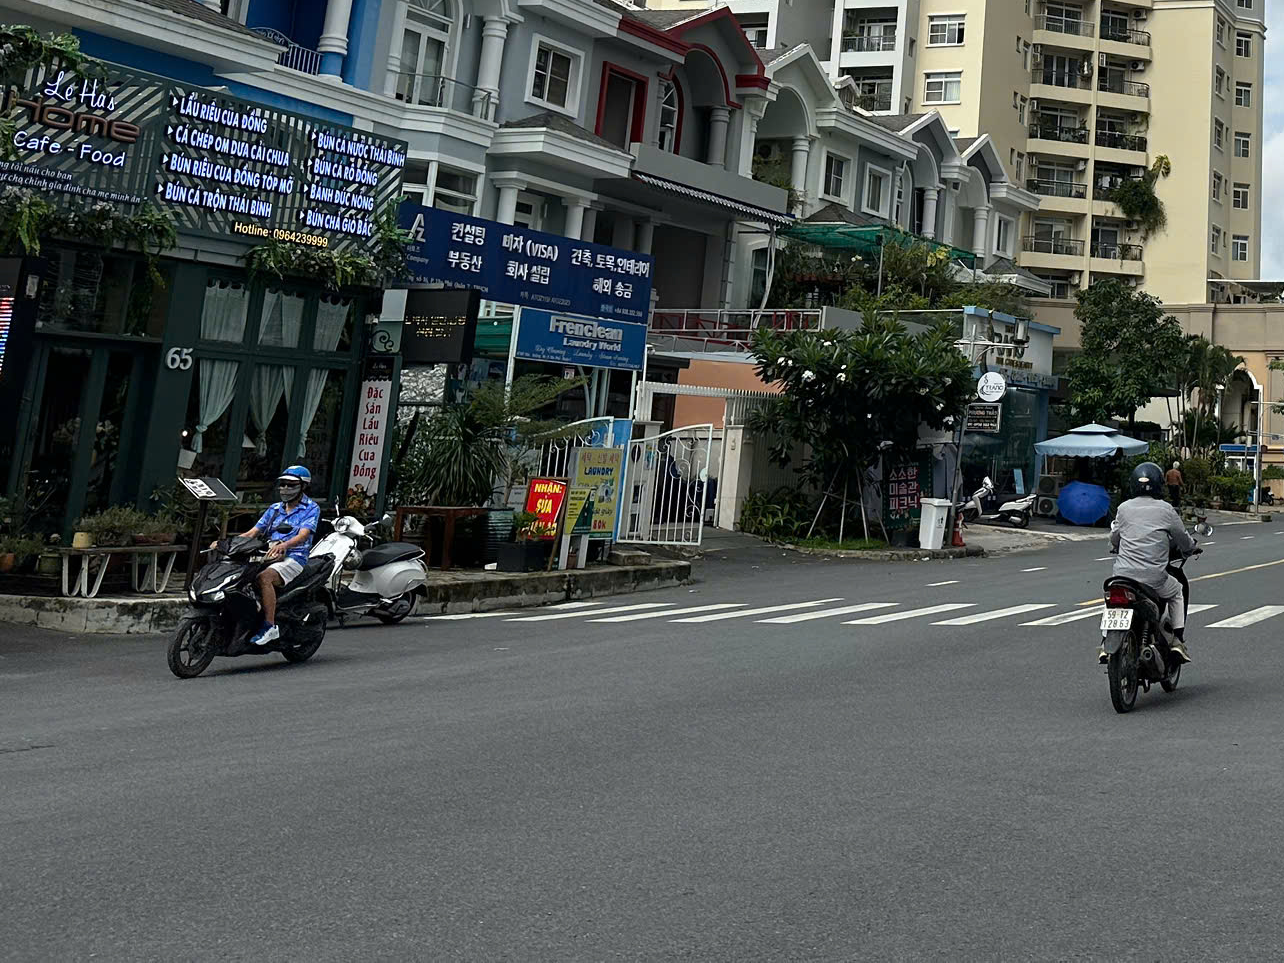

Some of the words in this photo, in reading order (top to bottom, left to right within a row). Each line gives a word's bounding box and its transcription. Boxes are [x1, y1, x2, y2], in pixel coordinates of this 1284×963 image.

[200, 102, 222, 124] RIÊU
[222, 111, 239, 128] CUA
[13, 131, 61, 154] Cafe
[80, 144, 126, 167] Food
[175, 124, 188, 144] CÁ
[190, 129, 213, 150] CHÉP
[215, 139, 229, 154] OM
[251, 141, 265, 161] CẢI
[267, 149, 290, 166] CHUA
[318, 131, 335, 151] BÚN
[336, 137, 346, 153] CÁ
[370, 145, 387, 163] THÁI
[170, 152, 190, 173] BÚN
[192, 158, 212, 179] RIÊU
[214, 167, 232, 183] CUA
[262, 172, 277, 191] TÓP
[314, 156, 331, 175] BÚN
[332, 161, 342, 178] CÁ
[344, 163, 354, 181] RÔ
[165, 181, 186, 202] BÚN
[188, 186, 200, 205] CÁ
[202, 189, 227, 212] TRỘN
[228, 194, 249, 213] THÁI
[251, 197, 272, 217] BÌNH
[310, 182, 334, 203] BÁNH
[334, 187, 350, 206] ĐÚC
[306, 208, 324, 227] BÚN
[235, 222, 272, 237] Hotline:
[274, 228, 328, 247] 0964239999
[451, 222, 486, 246] 컨설팅
[502, 234, 523, 253] 비자
[526, 239, 559, 262] (VISA)
[447, 250, 482, 272] 부동산
[505, 260, 529, 280] 회사
[530, 265, 551, 285] 설립
[592, 277, 612, 295] 해외
[614, 281, 633, 299] 송금
[549, 315, 623, 341] Frenclean
[563, 337, 597, 351] Laundry
[598, 341, 622, 352] World
[166, 347, 194, 371] 65
[367, 387, 383, 401] Đặc
[365, 401, 381, 414] Sản
[359, 433, 379, 446] Riêu
[359, 449, 375, 461] Cua
[584, 466, 613, 476] LAUNDRY
[889, 467, 917, 481] 소소한
[889, 481, 918, 496] 미술관
[889, 495, 917, 510] 피크닉
